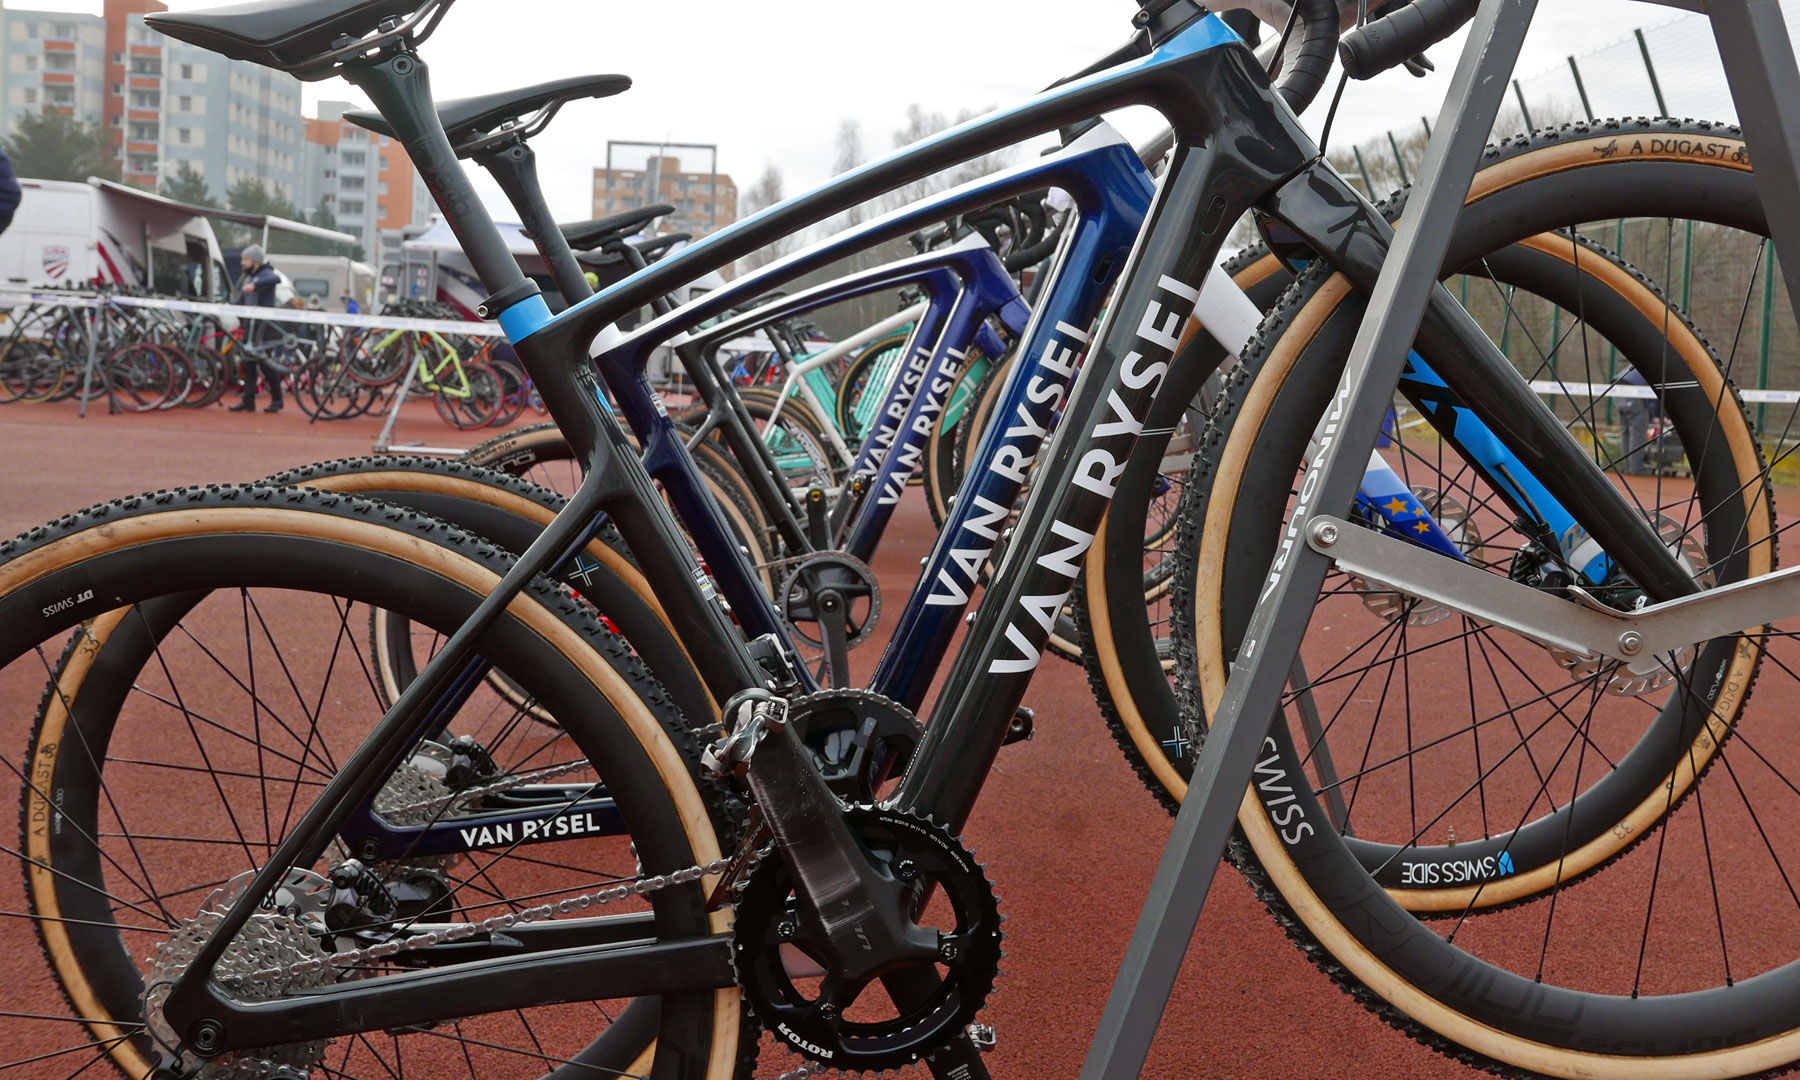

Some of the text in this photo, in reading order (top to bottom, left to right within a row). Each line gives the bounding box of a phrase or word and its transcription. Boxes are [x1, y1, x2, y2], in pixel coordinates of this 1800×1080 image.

[1630, 139, 1731, 159] A DUGAST
[877, 444, 920, 506] VAN
[912, 344, 971, 436] RYSEL
[858, 424, 896, 478] VAN
[925, 319, 1098, 606] VAN RYSEL
[988, 274, 1202, 674] VAN RYSEL
[1260, 366, 1352, 606] MINOURA
[42, 589, 94, 618] DT SWISS
[459, 812, 600, 849] VAN RYSEL
[1402, 855, 1498, 885] SWISS SIDE
[778, 1022, 834, 1059] ROTOR
